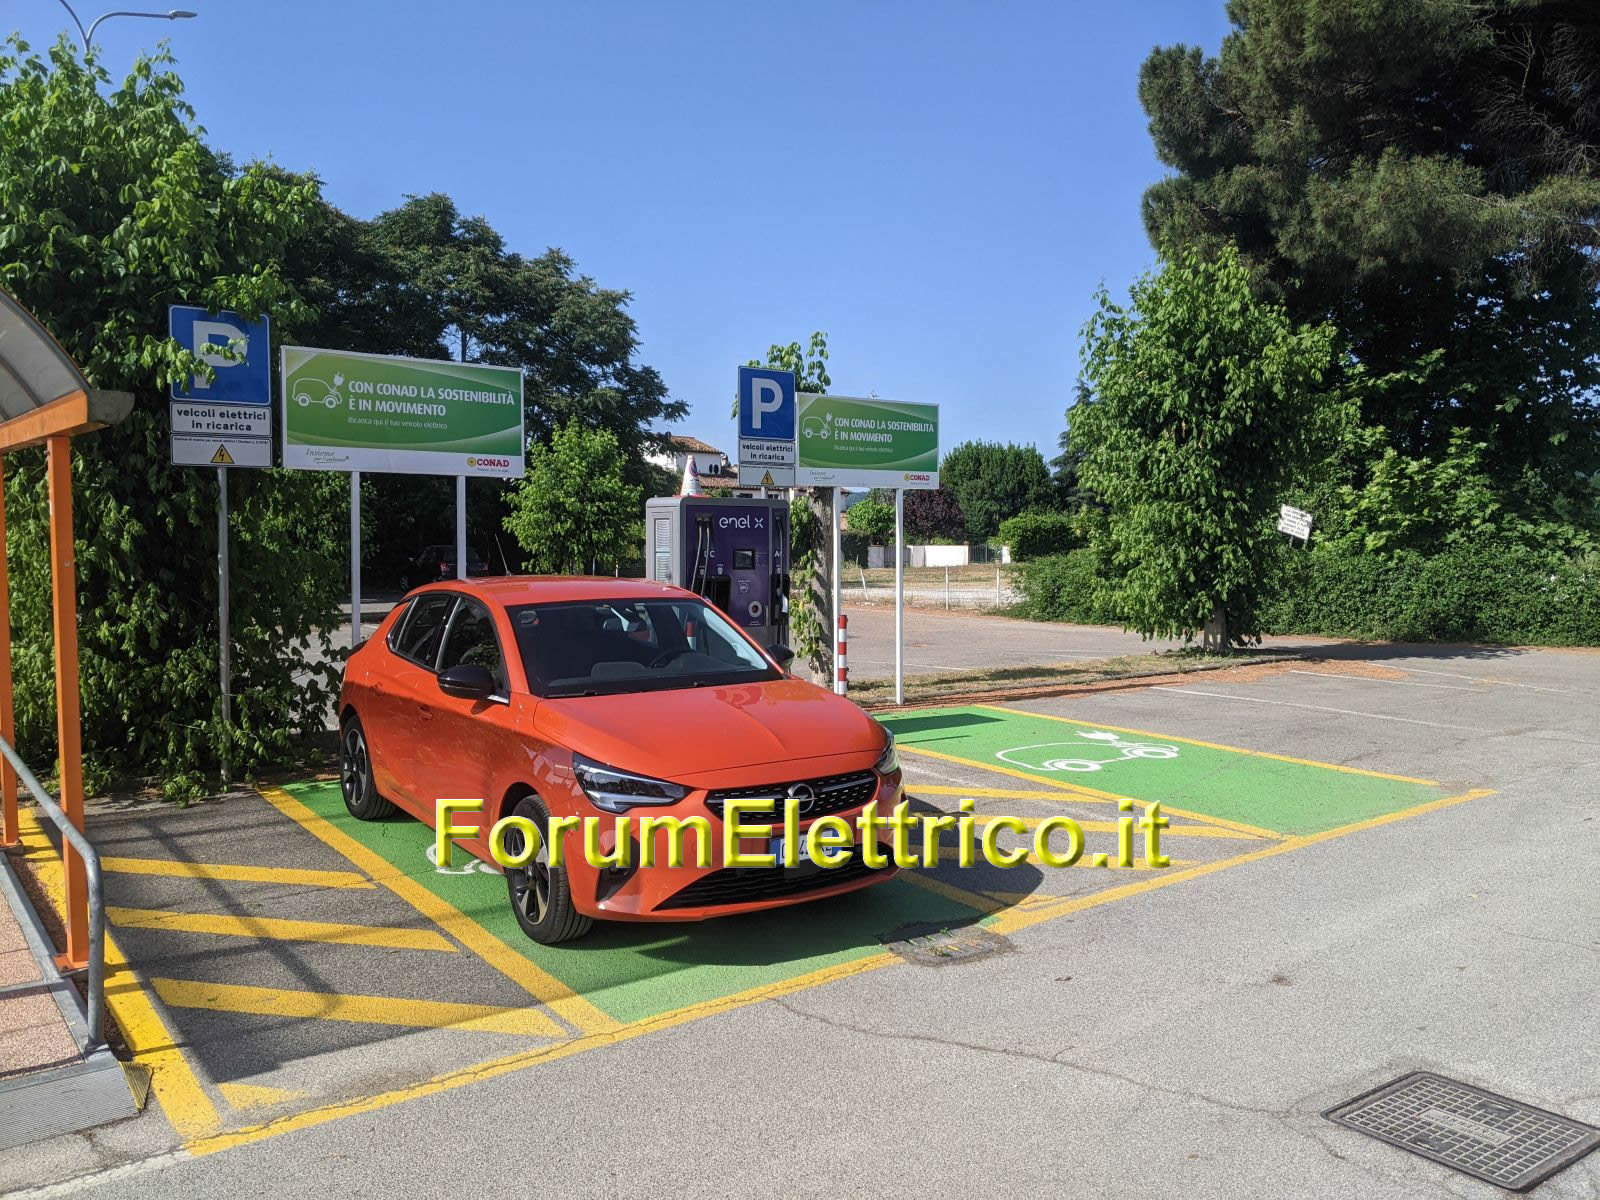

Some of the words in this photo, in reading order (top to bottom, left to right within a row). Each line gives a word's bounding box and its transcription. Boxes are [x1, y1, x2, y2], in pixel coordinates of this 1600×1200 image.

[193, 320, 248, 389] P
[348, 381, 374, 394] CON
[376, 383, 418, 397] CONAD
[420, 386, 436, 399] LA
[438, 388, 515, 406] SOSTENIBILITÀ
[348, 395, 356, 410] È
[358, 399, 372, 412] IN
[375, 400, 447, 416] MOVIMENTO
[752, 377, 784, 429] P
[176, 408, 215, 418] veicoli
[219, 410, 266, 421] elettrici
[191, 420, 202, 429] in
[206, 421, 252, 431] ricarica
[834, 417, 850, 427] CON
[851, 418, 876, 429] CONAD
[877, 420, 886, 430] LA
[887, 420, 934, 433] SOSTENIBILITÀ
[840, 431, 849, 441] IN
[850, 431, 893, 443] MOVIMENTO
[742, 443, 765, 451] veicoli
[766, 445, 793, 453] elettrici
[476, 458, 510, 468] CONAD
[750, 452, 757, 460] in
[759, 453, 785, 461] ricarica
[718, 513, 751, 529] enel
